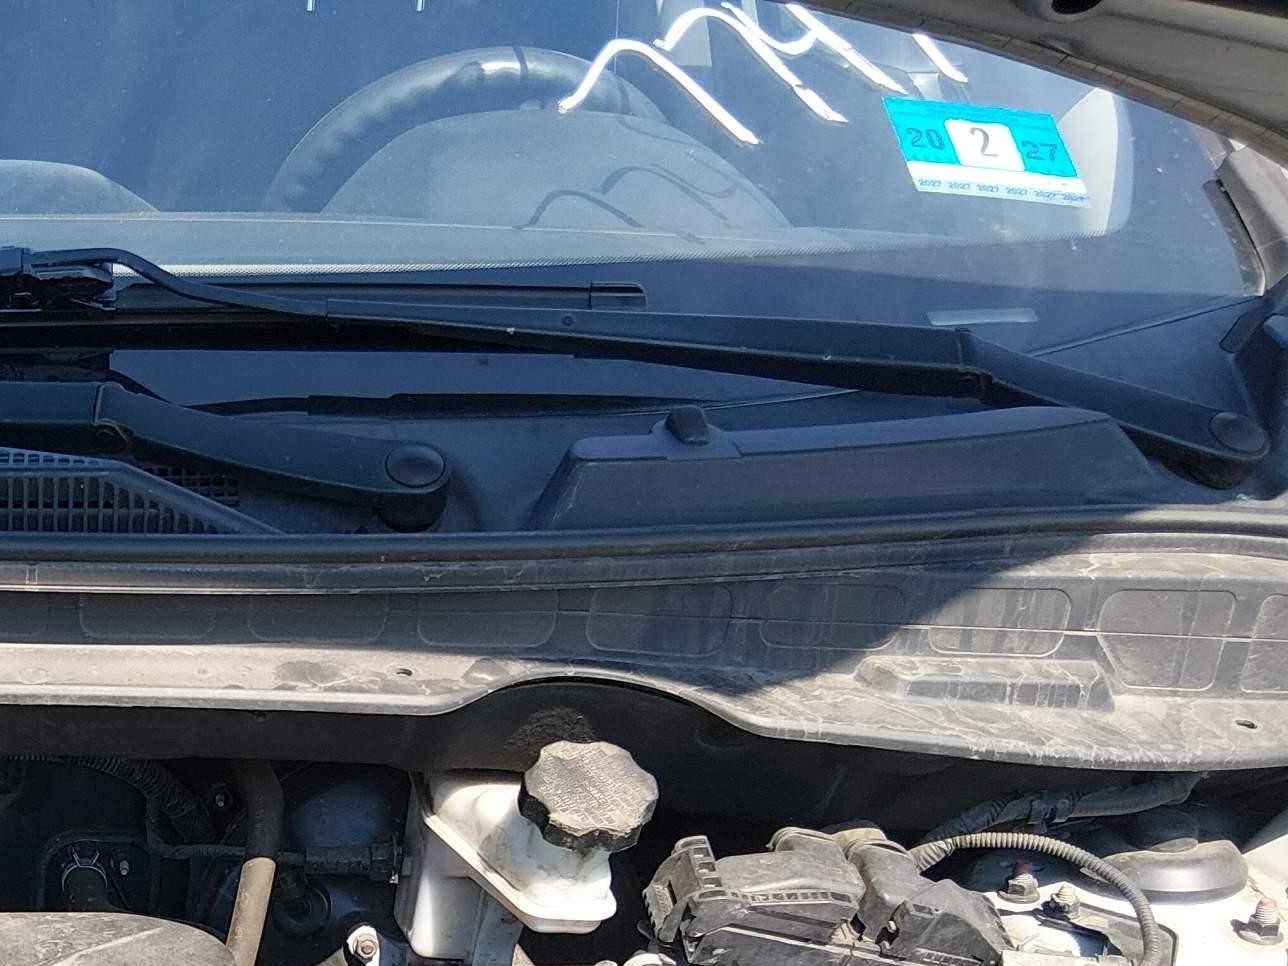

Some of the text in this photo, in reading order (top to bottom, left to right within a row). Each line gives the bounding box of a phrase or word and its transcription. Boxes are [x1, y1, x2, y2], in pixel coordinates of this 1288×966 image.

[906, 127, 1058, 162] 20 2 27
